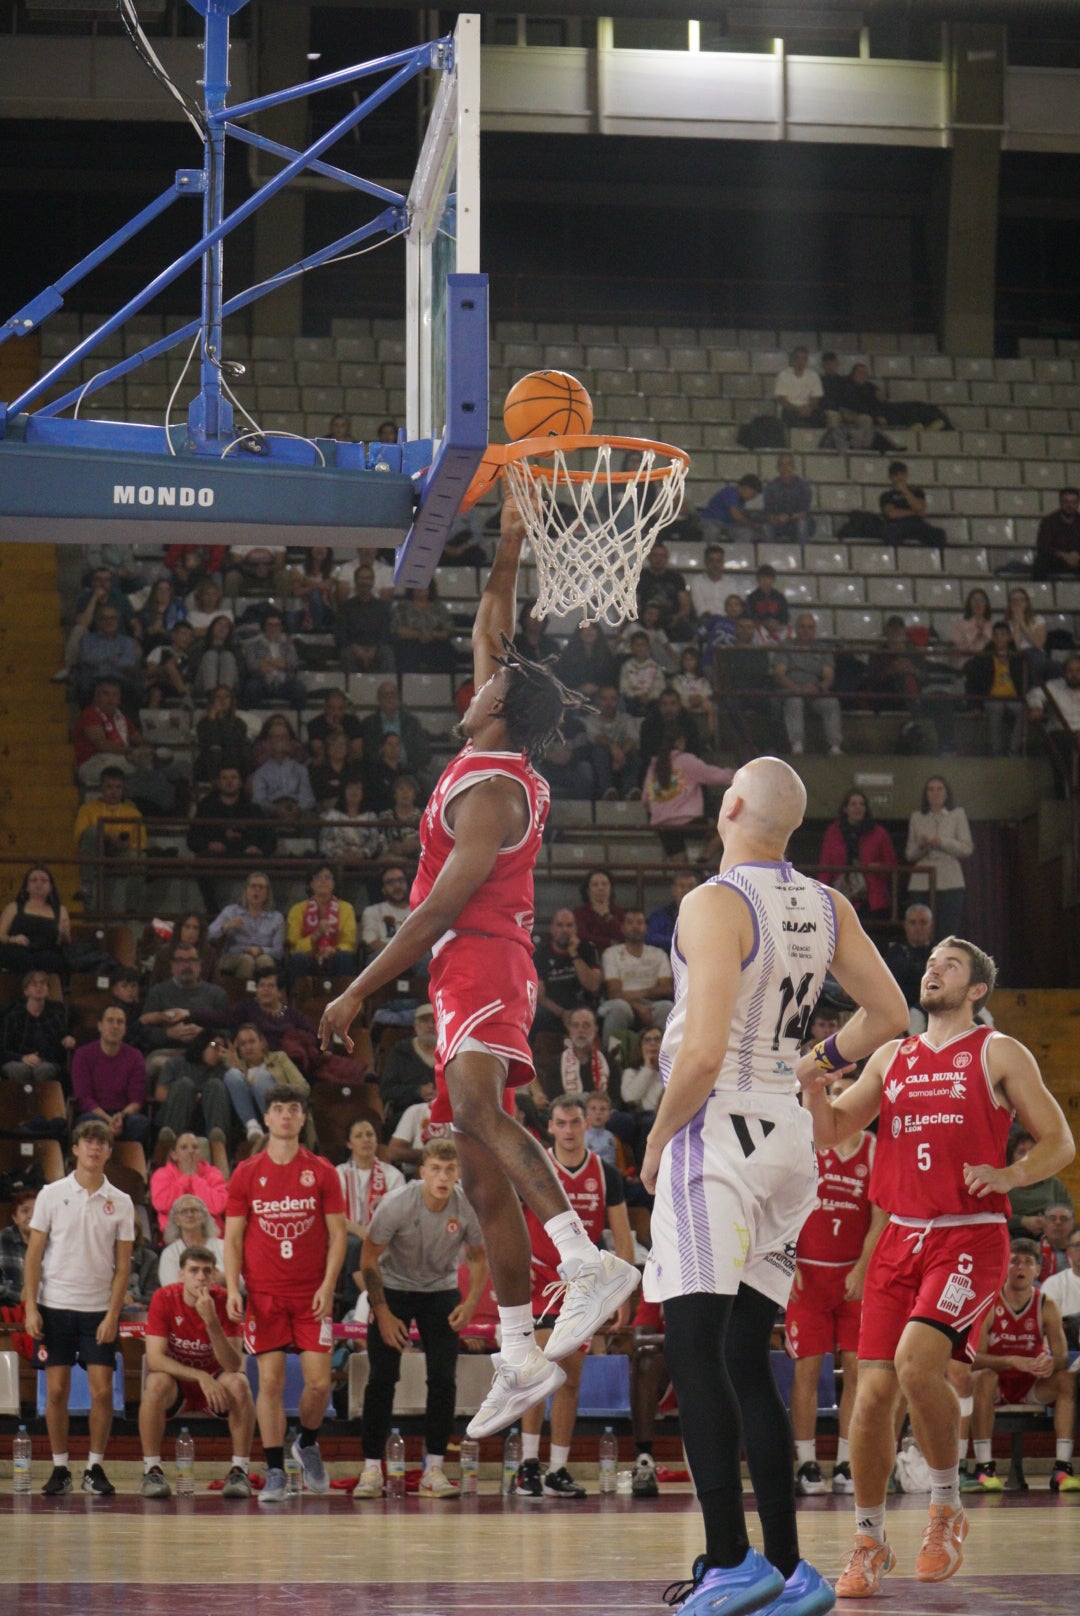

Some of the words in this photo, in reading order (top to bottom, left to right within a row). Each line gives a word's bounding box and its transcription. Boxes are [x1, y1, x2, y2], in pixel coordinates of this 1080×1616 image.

[113, 485, 214, 507] MONDO
[905, 1074, 930, 1084] CAJA
[932, 1072, 967, 1082] RURAL
[904, 1113, 964, 1126] E.Leclerc
[917, 1142, 931, 1171] 5
[252, 1195, 317, 1214] Ezedent
[832, 1218, 842, 1236] 7
[280, 1240, 293, 1259] 8
